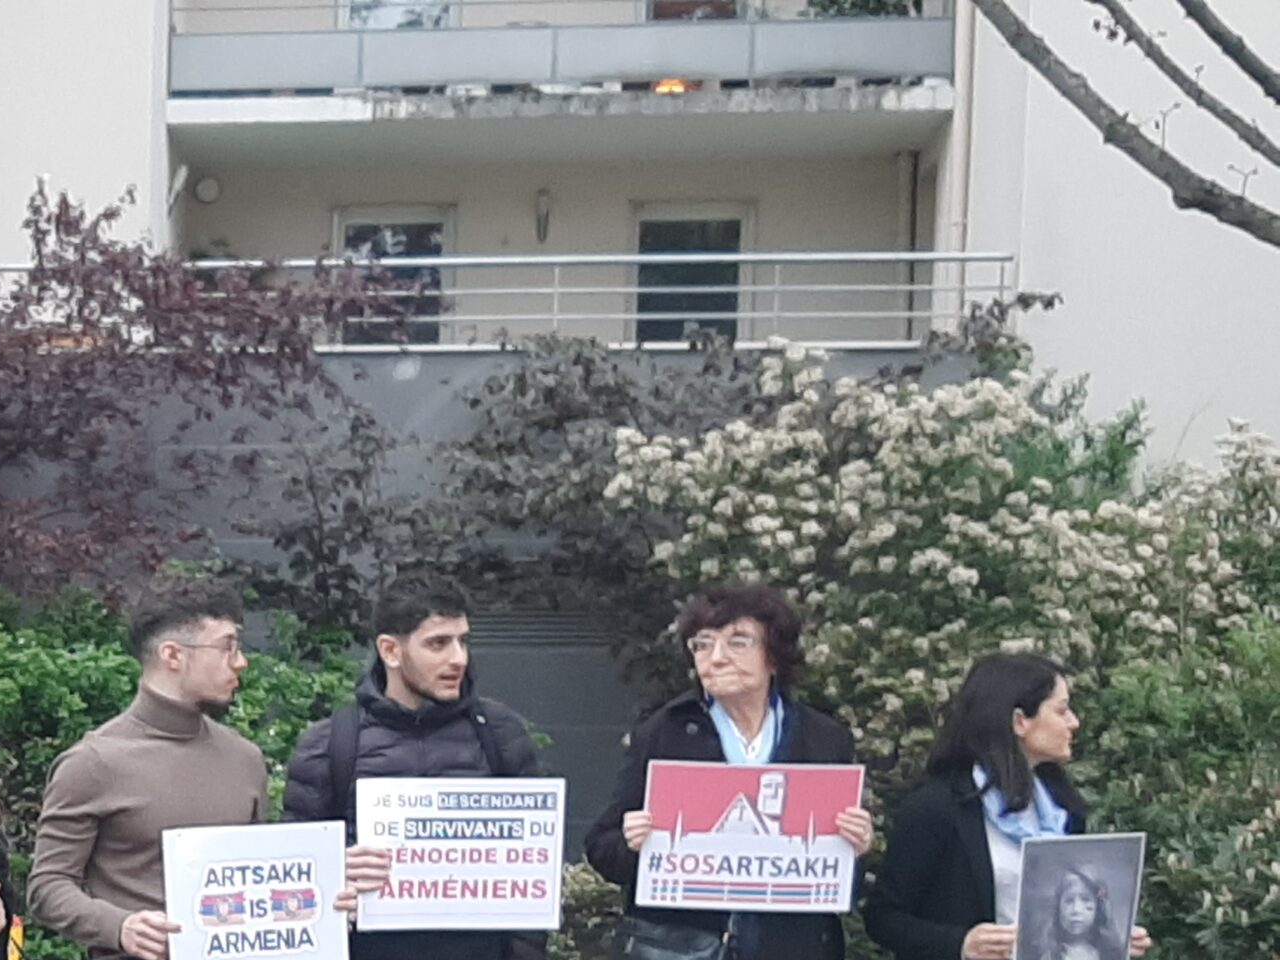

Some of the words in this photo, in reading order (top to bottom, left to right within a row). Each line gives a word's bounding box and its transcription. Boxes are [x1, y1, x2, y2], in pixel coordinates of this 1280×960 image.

[373, 794, 392, 808] JE
[398, 794, 433, 808] SUIS
[373, 821, 399, 836] DE
[405, 821, 523, 838] SURVIVANTS
[530, 821, 555, 836] DU
[506, 848, 549, 864] DES
[648, 852, 839, 878] #SOSARTSAKH
[204, 862, 312, 888] ARTSAKH
[379, 874, 548, 899] ARMÉNIENS
[249, 898, 268, 919] IS
[207, 927, 314, 956] ARMENIA
